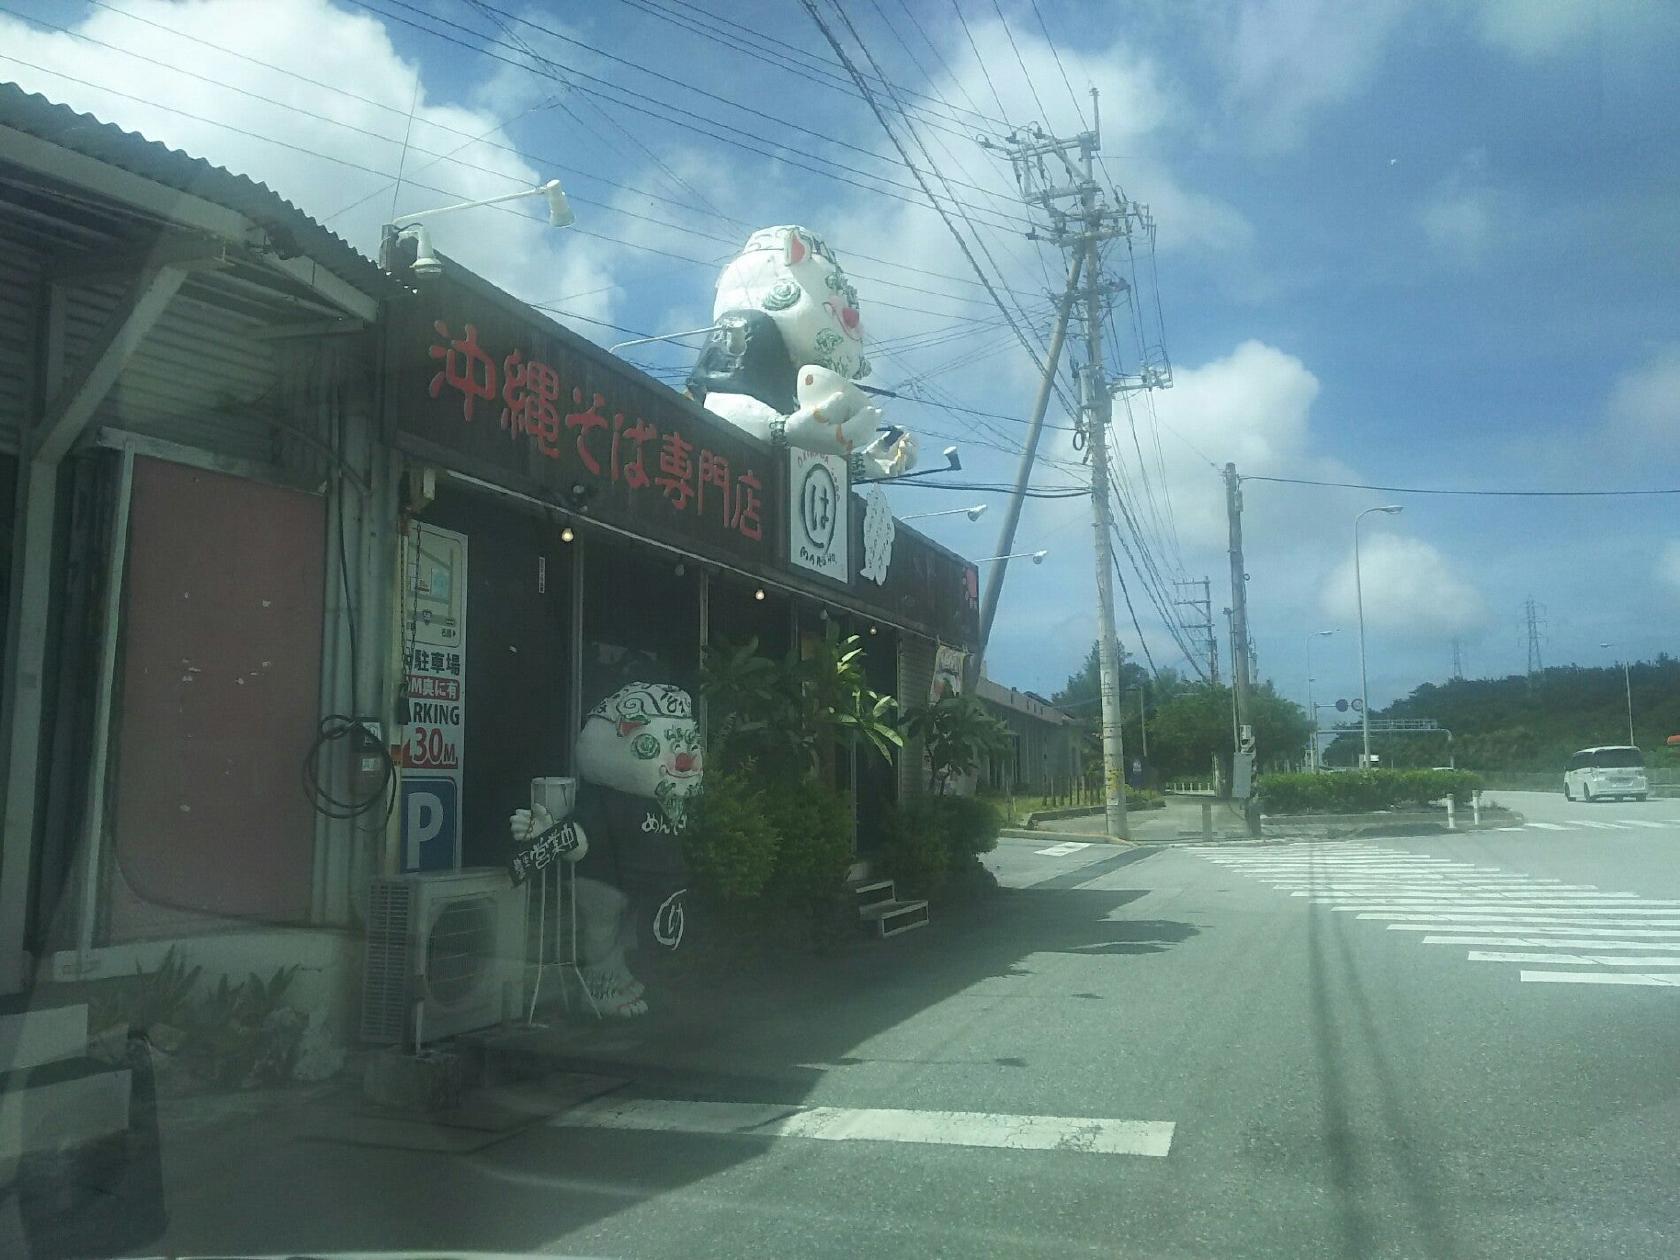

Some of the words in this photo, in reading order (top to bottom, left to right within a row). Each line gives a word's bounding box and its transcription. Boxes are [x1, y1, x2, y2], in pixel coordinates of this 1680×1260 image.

[428, 319, 763, 541] 沖縄そば専門店
[408, 701, 460, 726] RKING
[405, 791, 445, 870] P
